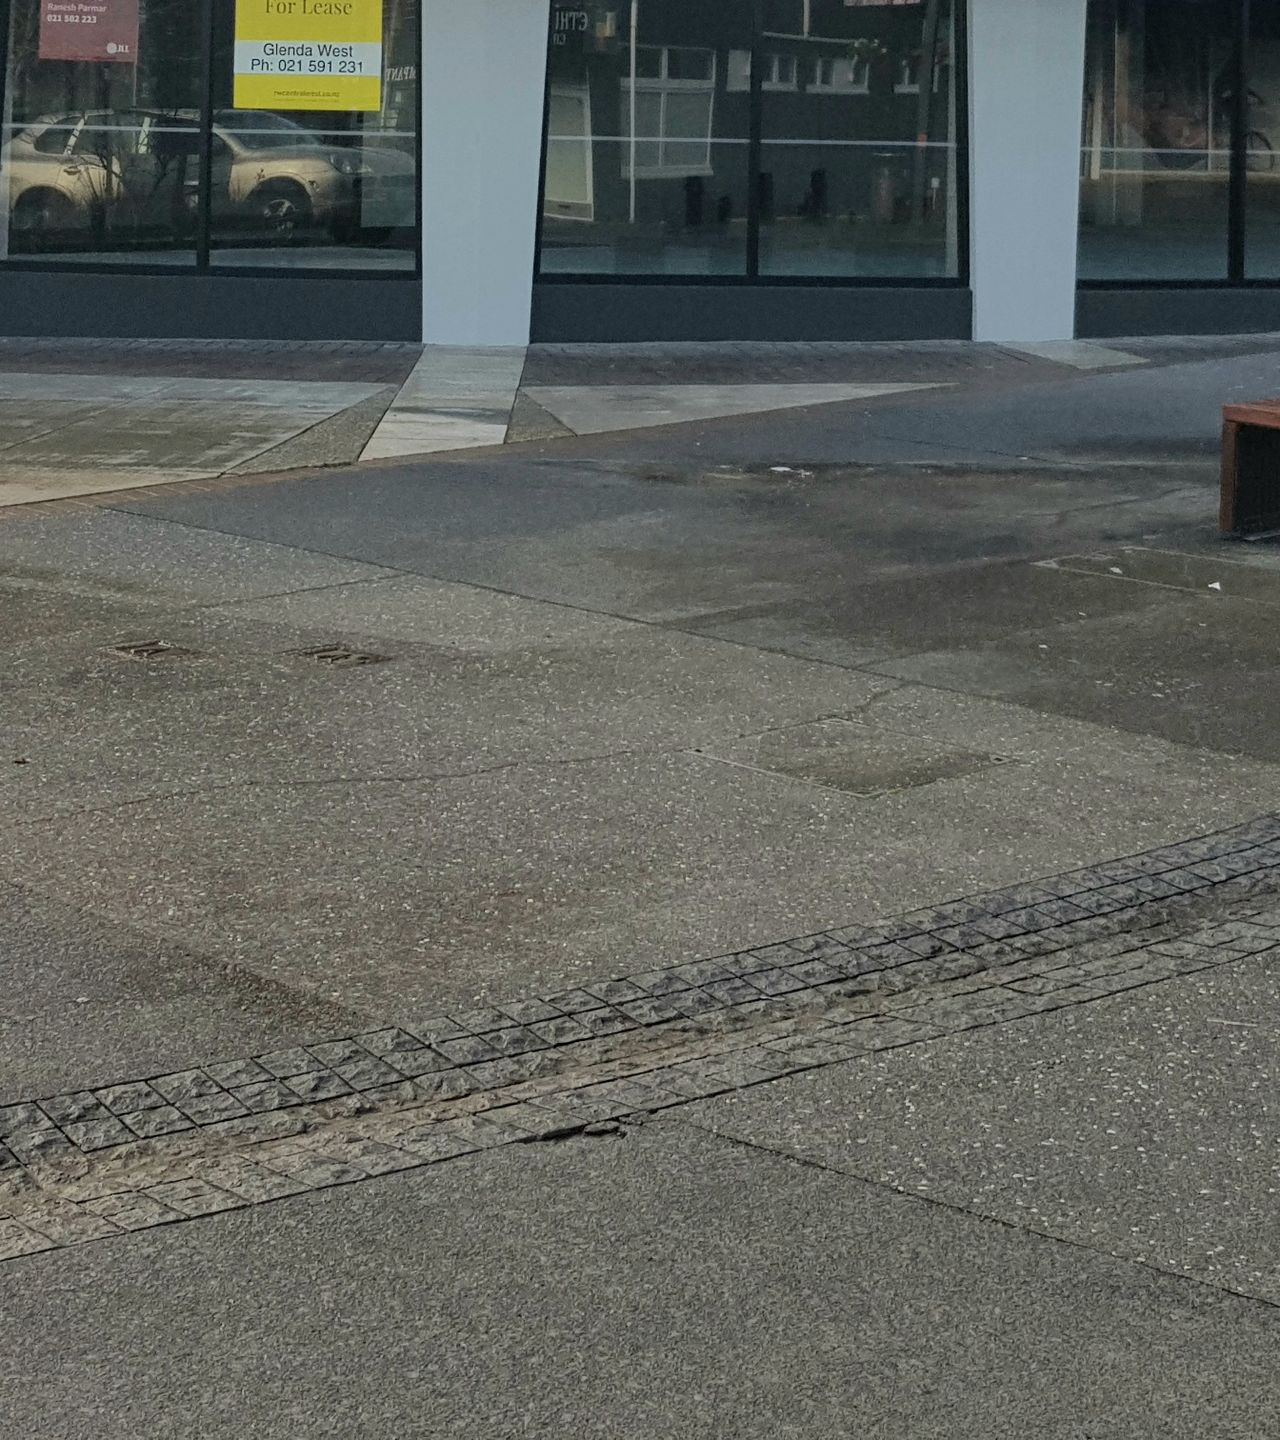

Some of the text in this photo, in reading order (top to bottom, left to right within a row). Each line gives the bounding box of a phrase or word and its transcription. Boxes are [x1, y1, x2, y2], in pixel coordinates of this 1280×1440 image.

[263, 43, 353, 58] Glenda West
[251, 58, 363, 73] Ph: 021 591 231
